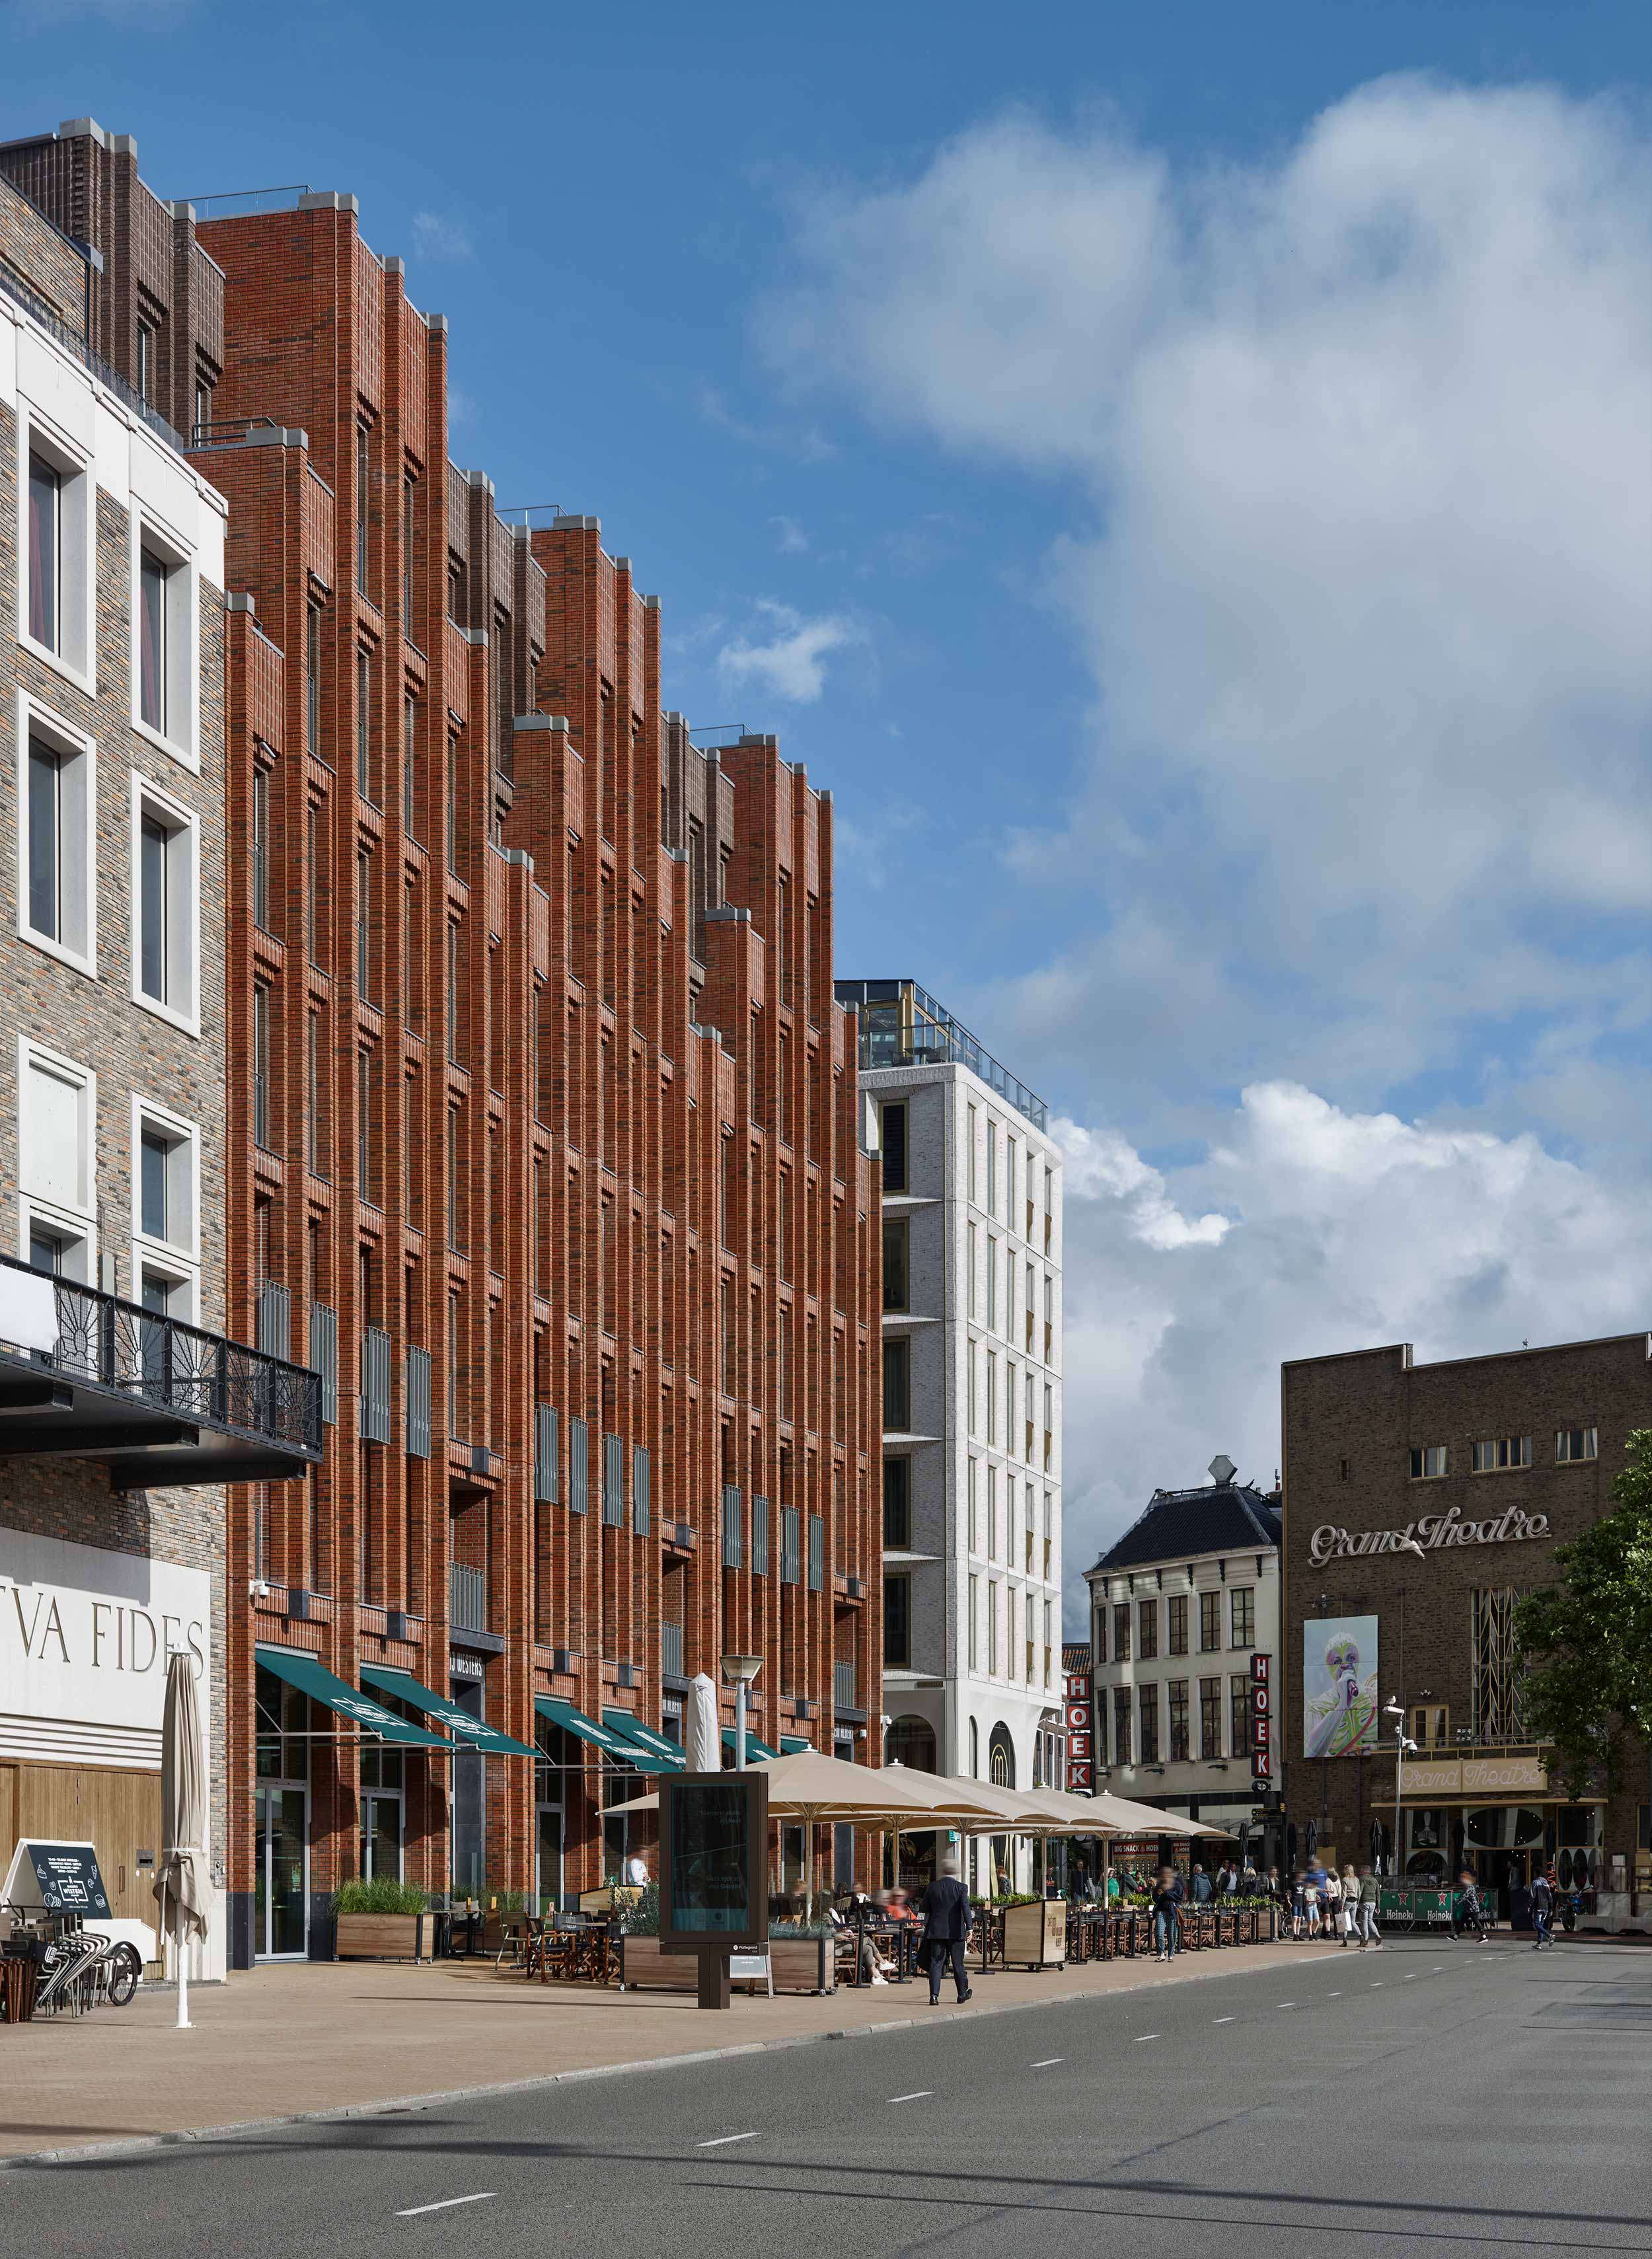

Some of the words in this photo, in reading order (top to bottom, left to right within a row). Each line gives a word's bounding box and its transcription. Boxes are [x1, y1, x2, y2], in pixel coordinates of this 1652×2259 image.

[1307, 1523, 1416, 1568] Grand
[1417, 1506, 1548, 1550] Theatre
[0, 1585, 70, 1663] VA
[91, 1602, 204, 1680] FIDES
[457, 1652, 482, 1677] WESTERS
[1070, 1678, 1087, 1784] HOEK
[1258, 1658, 1267, 1773] HOEK
[1401, 1766, 1459, 1791] Grand
[1464, 1760, 1542, 1785] Theatre
